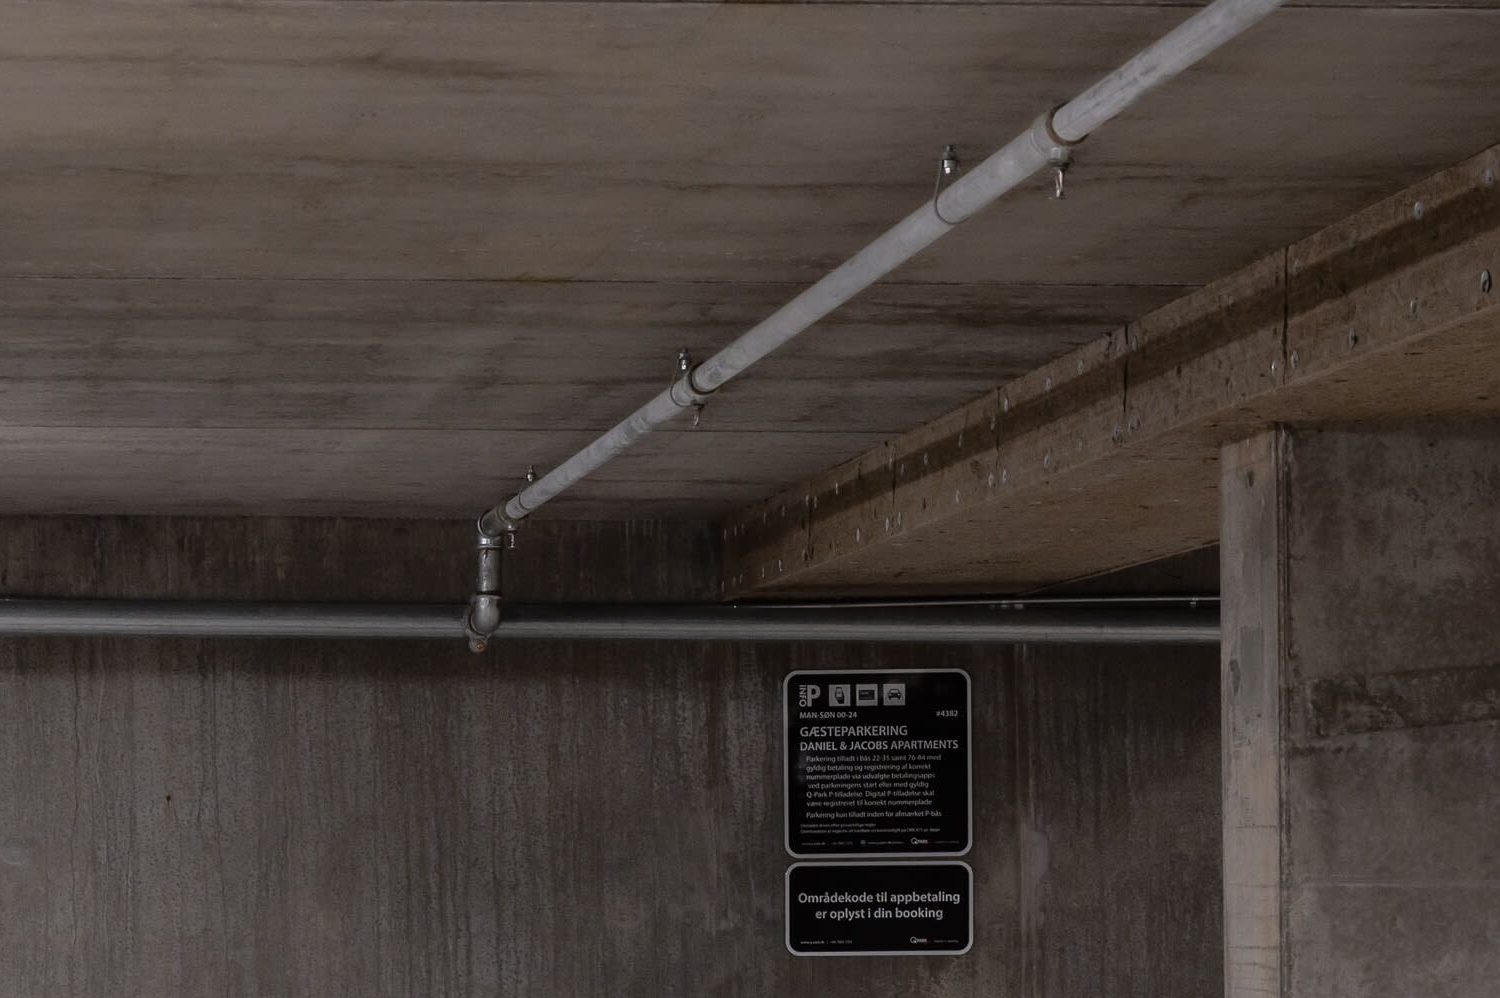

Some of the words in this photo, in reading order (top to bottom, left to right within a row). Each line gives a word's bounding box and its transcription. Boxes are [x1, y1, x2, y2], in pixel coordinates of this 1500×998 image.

[798, 685, 807, 707] INFO
[807, 684, 821, 707] P
[799, 711, 835, 719] MAN-SØN
[836, 711, 858, 719] 00-24
[799, 725, 909, 737] GÆSTEPARKERING
[800, 741, 838, 751] DANIEL
[839, 741, 848, 750] &
[849, 740, 889, 750] JACOBS
[890, 739, 959, 750] APARTMENTS
[805, 755, 836, 763] Parkering
[805, 764, 826, 772] gyldig
[827, 764, 853, 772] betaling
[908, 781, 929, 789] gyldig
[805, 810, 836, 819] Parkering
[798, 891, 874, 904] Områdekode
[875, 891, 888, 903] til
[890, 890, 961, 905] appbetaling
[815, 910, 828, 919] er
[829, 907, 866, 922] oplyst
[867, 907, 871, 919] i
[873, 907, 893, 919] din
[895, 907, 944, 921] booking
